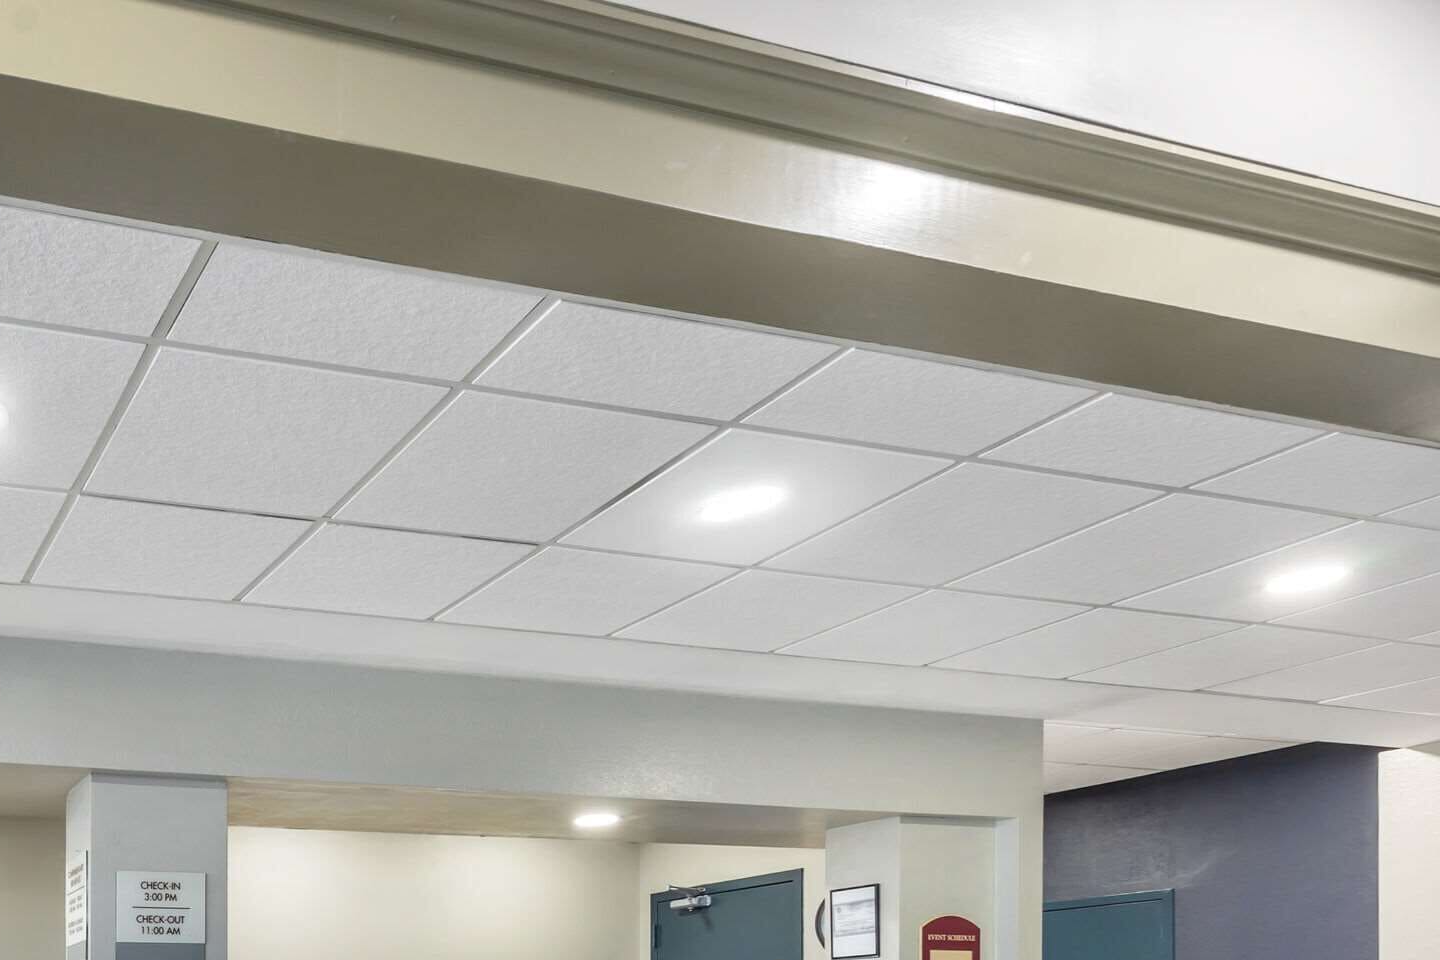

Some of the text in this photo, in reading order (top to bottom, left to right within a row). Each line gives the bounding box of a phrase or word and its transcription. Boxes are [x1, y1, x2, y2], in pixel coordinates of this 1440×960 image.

[140, 881, 181, 891] CHECK-IN
[144, 892, 178, 902] 3:00 PM
[136, 914, 185, 924] CHECK-OUT
[141, 926, 181, 936] 11:00 AM
[947, 934, 976, 942] SCHEDULE
